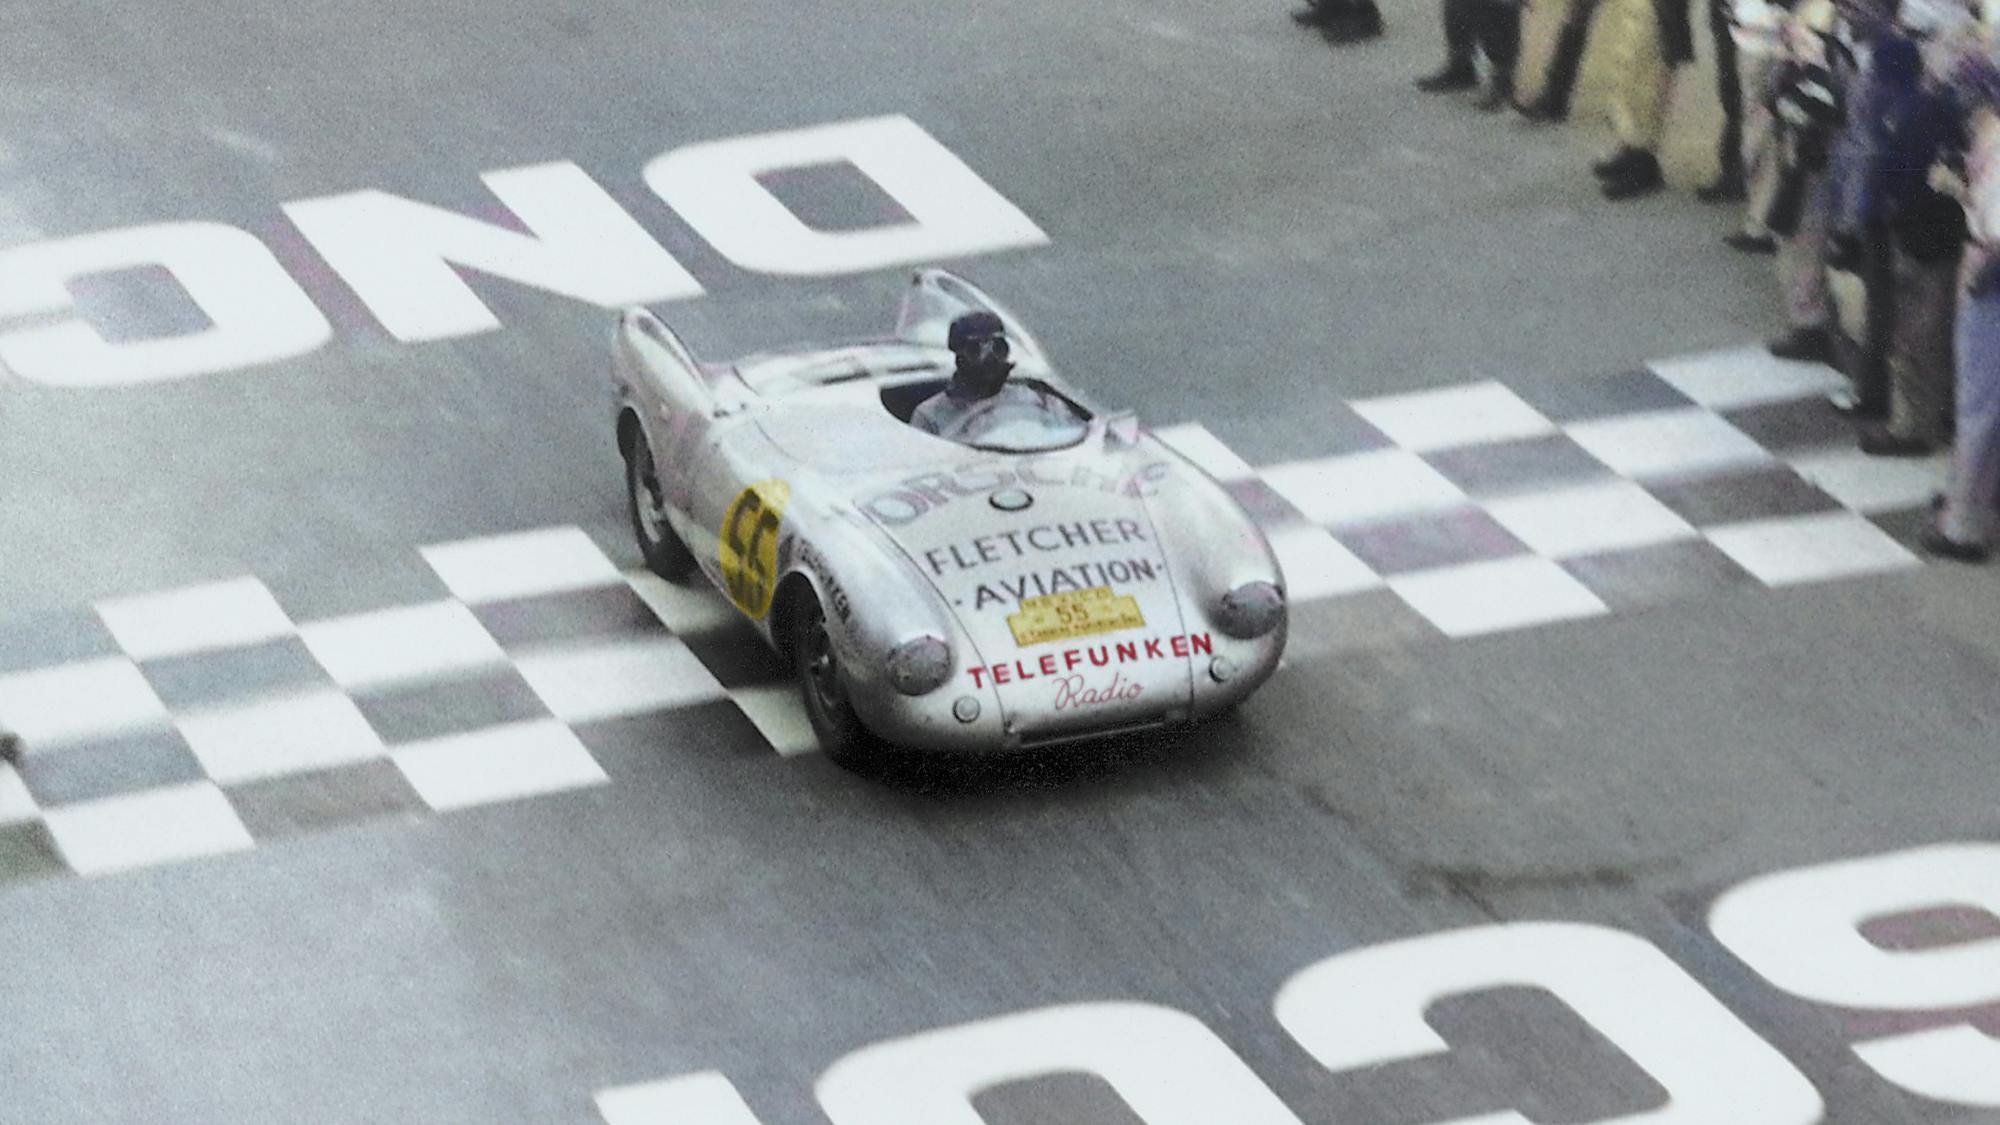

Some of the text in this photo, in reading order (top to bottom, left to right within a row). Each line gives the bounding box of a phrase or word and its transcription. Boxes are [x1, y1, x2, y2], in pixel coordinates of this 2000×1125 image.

[926, 519, 1147, 575] FLETCHER
[1056, 603, 1089, 624] 55
[967, 633, 1214, 689] TELEFUNKEN
[1052, 673, 1146, 710] Radio
